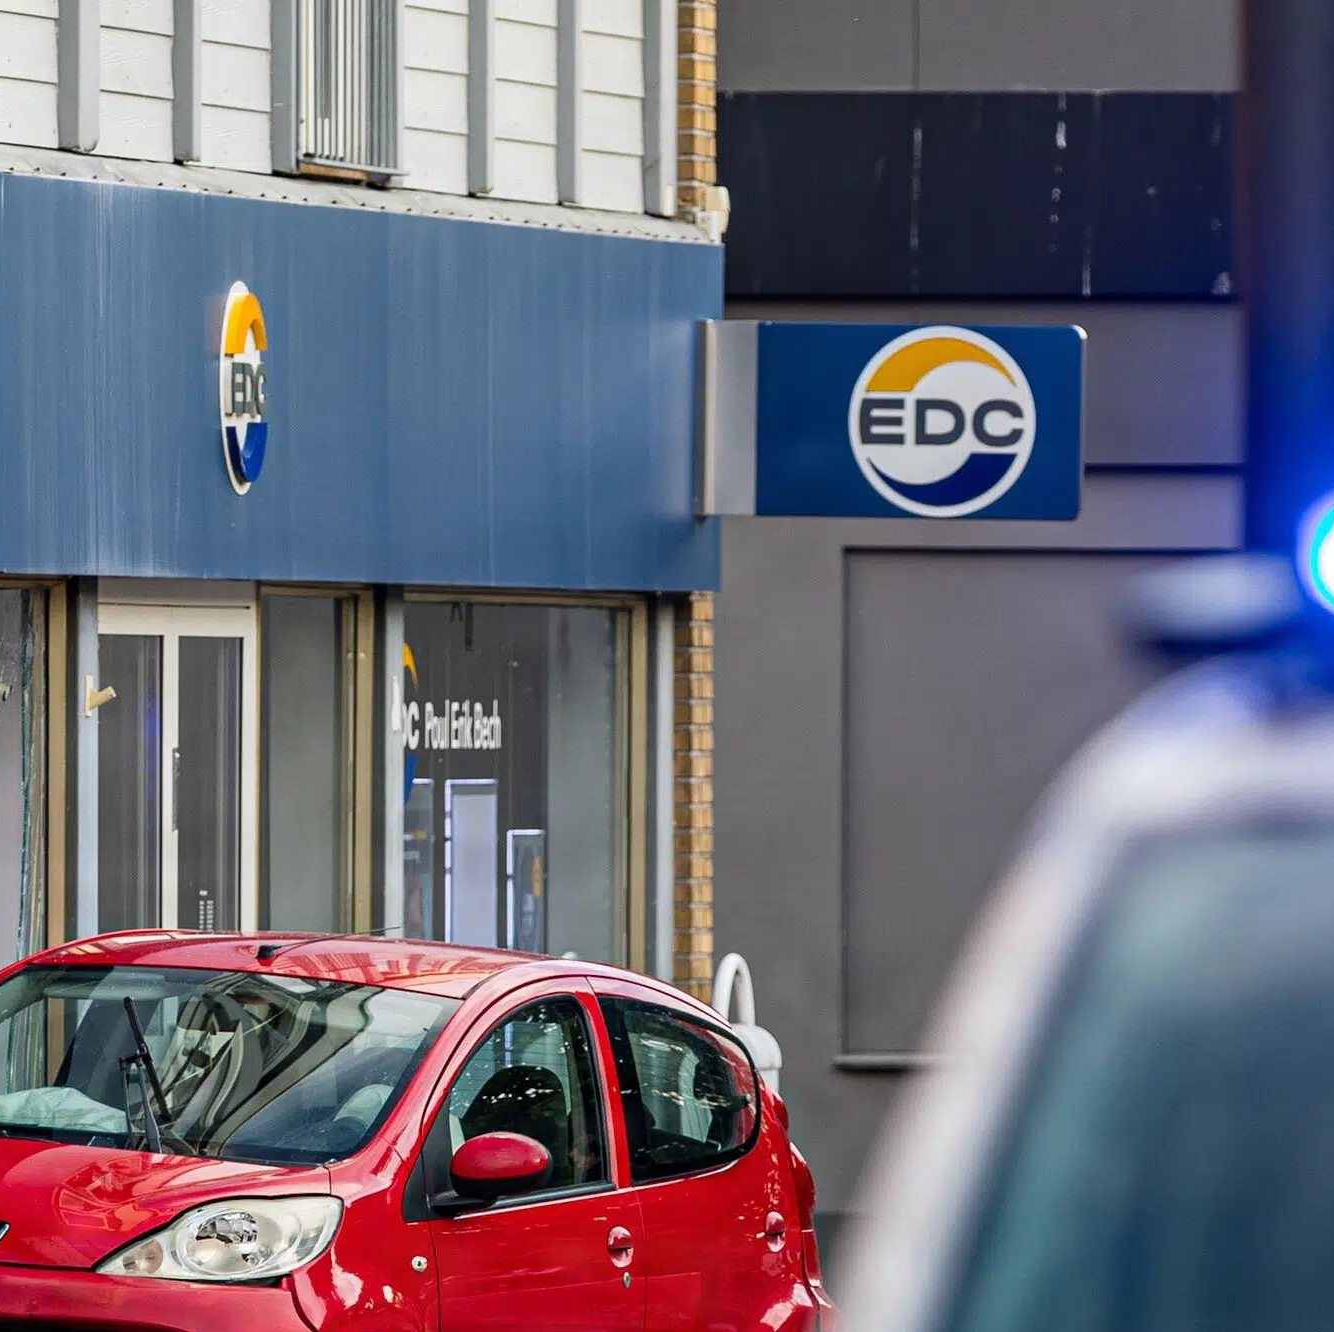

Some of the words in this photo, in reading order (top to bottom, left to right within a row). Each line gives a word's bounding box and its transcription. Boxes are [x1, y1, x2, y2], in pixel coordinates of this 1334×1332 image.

[226, 361, 269, 418] EDC
[858, 397, 1024, 447] EDC
[450, 699, 473, 749] Erik
[473, 699, 502, 750] Bech
